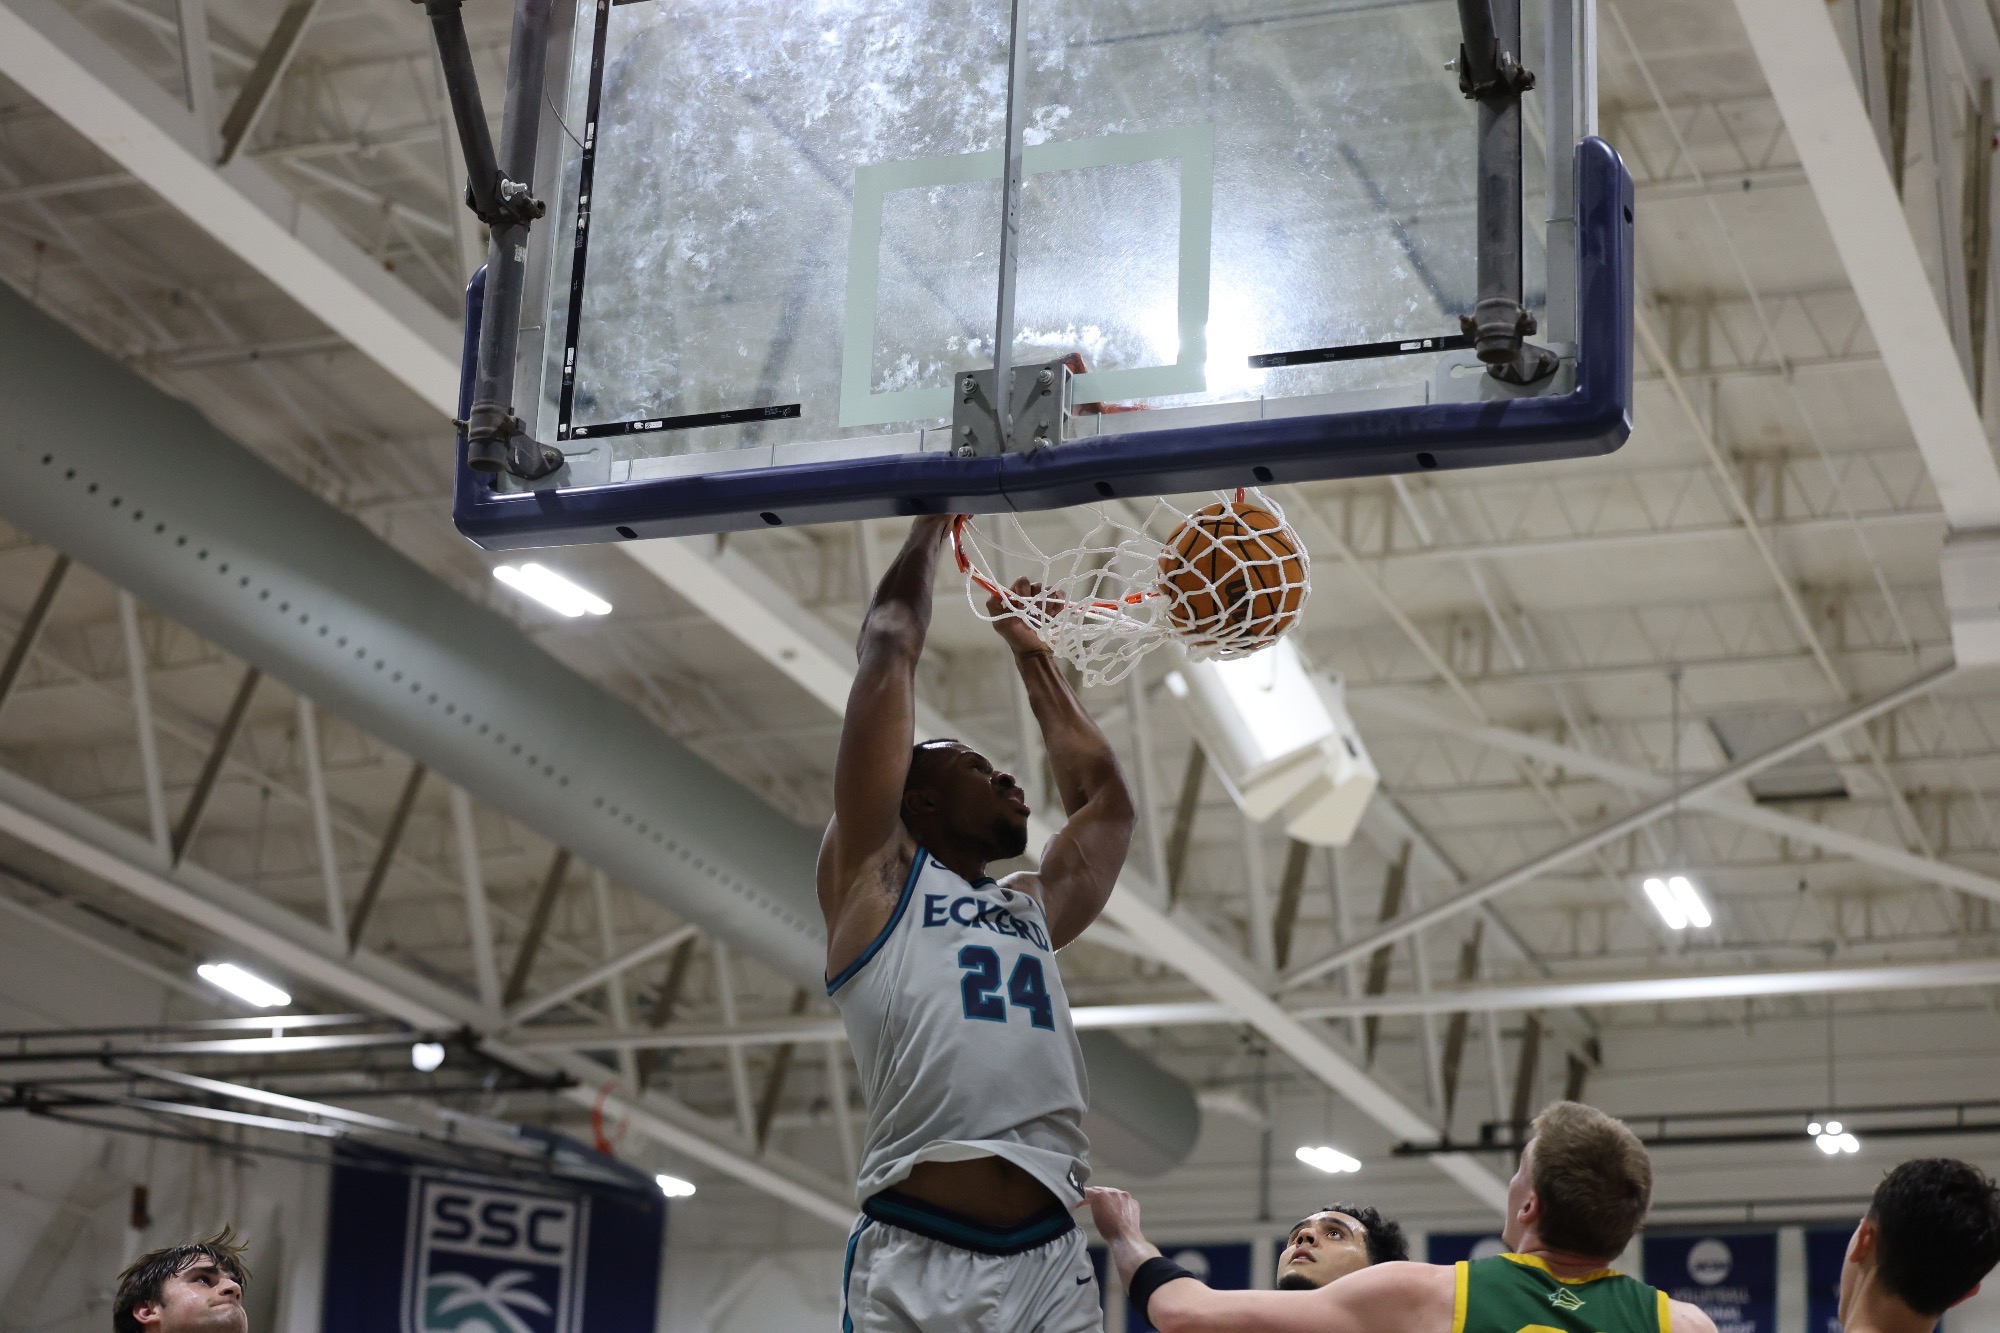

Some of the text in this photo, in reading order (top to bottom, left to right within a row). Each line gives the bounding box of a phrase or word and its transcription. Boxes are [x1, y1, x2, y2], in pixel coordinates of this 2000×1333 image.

[922, 893, 1050, 953] ECKERD
[957, 944, 1056, 1032] 24
[431, 1194, 565, 1257] SSC
